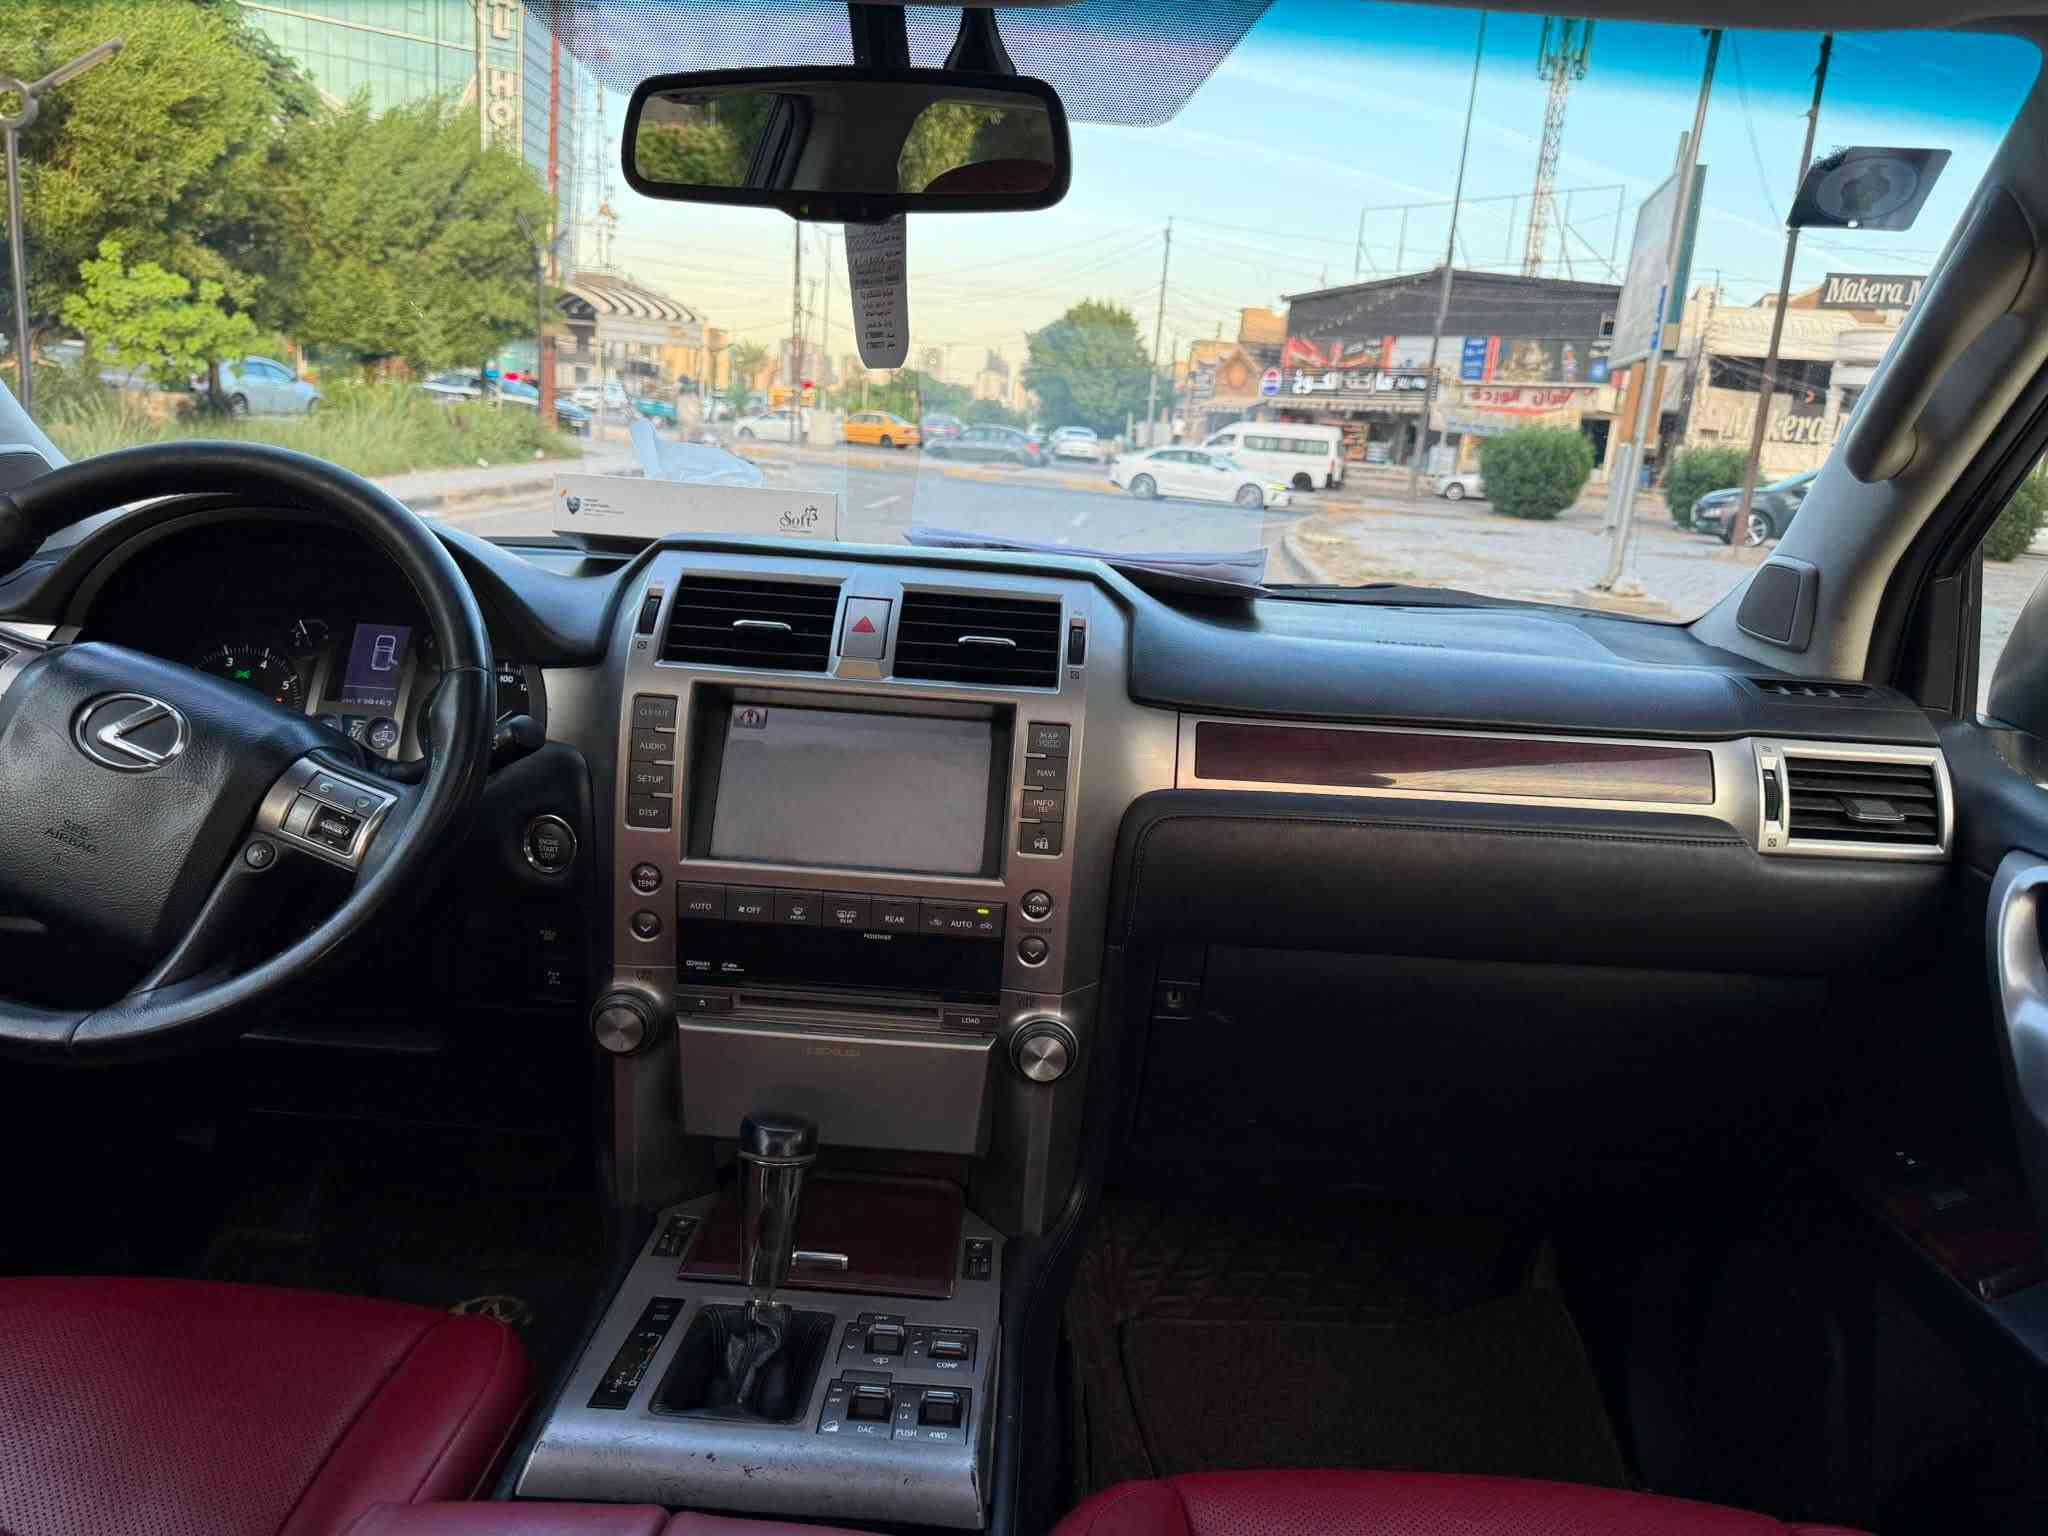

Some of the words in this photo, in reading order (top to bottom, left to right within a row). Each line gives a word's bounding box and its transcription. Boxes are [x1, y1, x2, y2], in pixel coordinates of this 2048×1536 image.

[1824, 277, 1905, 304] Makera
[1719, 405, 1826, 445] Mkera
[225, 657, 234, 668] 3
[259, 660, 268, 670] 4
[281, 681, 290, 690] 5
[639, 742, 667, 752] AUDIO
[1036, 769, 1056, 777] NAVI
[637, 774, 664, 785] SETUP
[1033, 799, 1055, 807] INFO
[638, 808, 659, 817] DISP
[689, 903, 713, 912] AUTO
[746, 906, 761, 915] OFF
[1028, 904, 1047, 913] TEMP
[884, 914, 905, 924] REAR
[950, 919, 973, 929] AUTO
[857, 1424, 875, 1434] DAC
[895, 1428, 918, 1438] PUSH
[928, 1431, 949, 1440] 4WD
